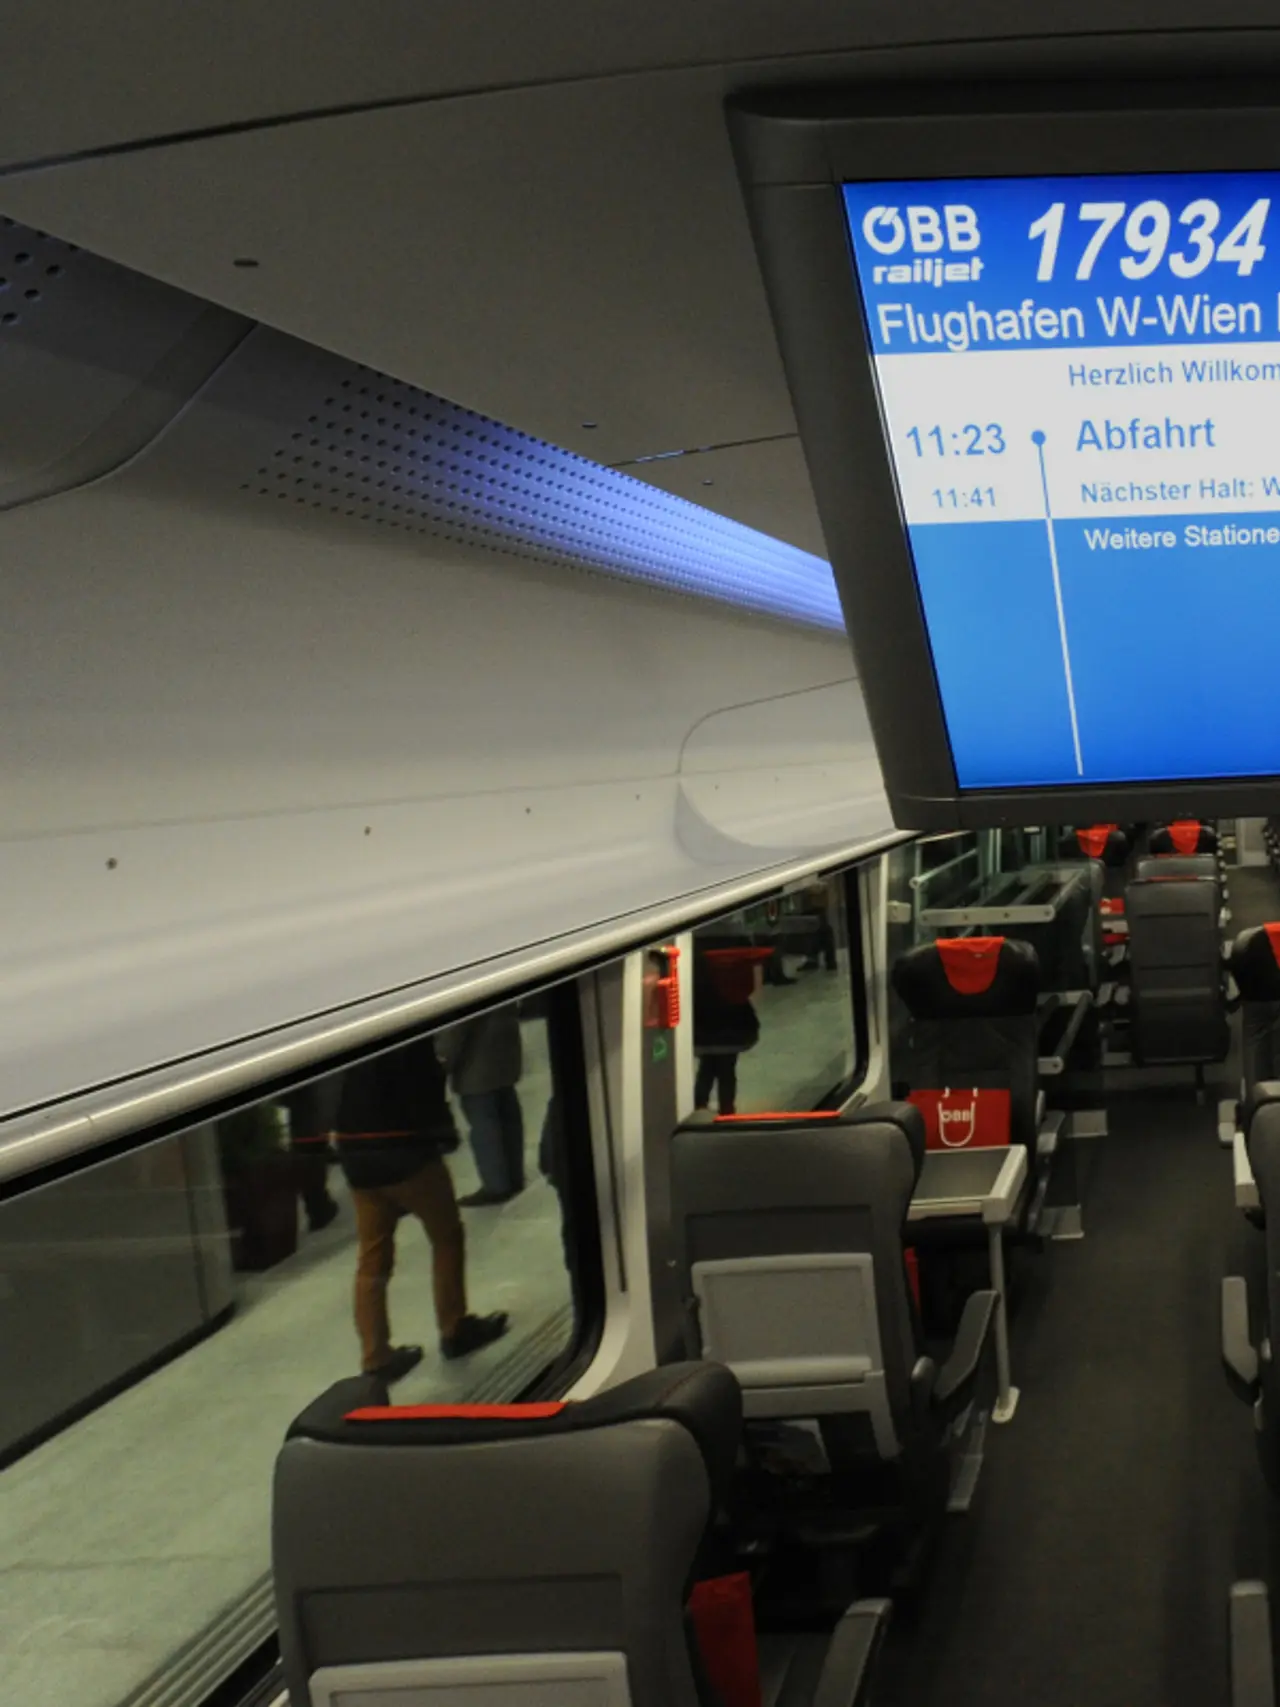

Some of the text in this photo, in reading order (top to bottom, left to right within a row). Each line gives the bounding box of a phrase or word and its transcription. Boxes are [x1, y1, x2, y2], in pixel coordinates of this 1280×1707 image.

[863, 204, 980, 254] ÖBB
[1027, 198, 1271, 281] 17934
[873, 256, 983, 287] railjet
[877, 298, 1085, 352] Flughafen
[1096, 294, 1260, 337] W-Wien
[1068, 360, 1173, 387] Herzlich
[906, 423, 1006, 457] 11:23
[1076, 417, 1215, 452] Abfahrt
[933, 487, 996, 508] 11:41
[1080, 481, 1192, 503] Nächster
[1200, 478, 1254, 499] Halt:
[1084, 527, 1177, 551] Weitere
